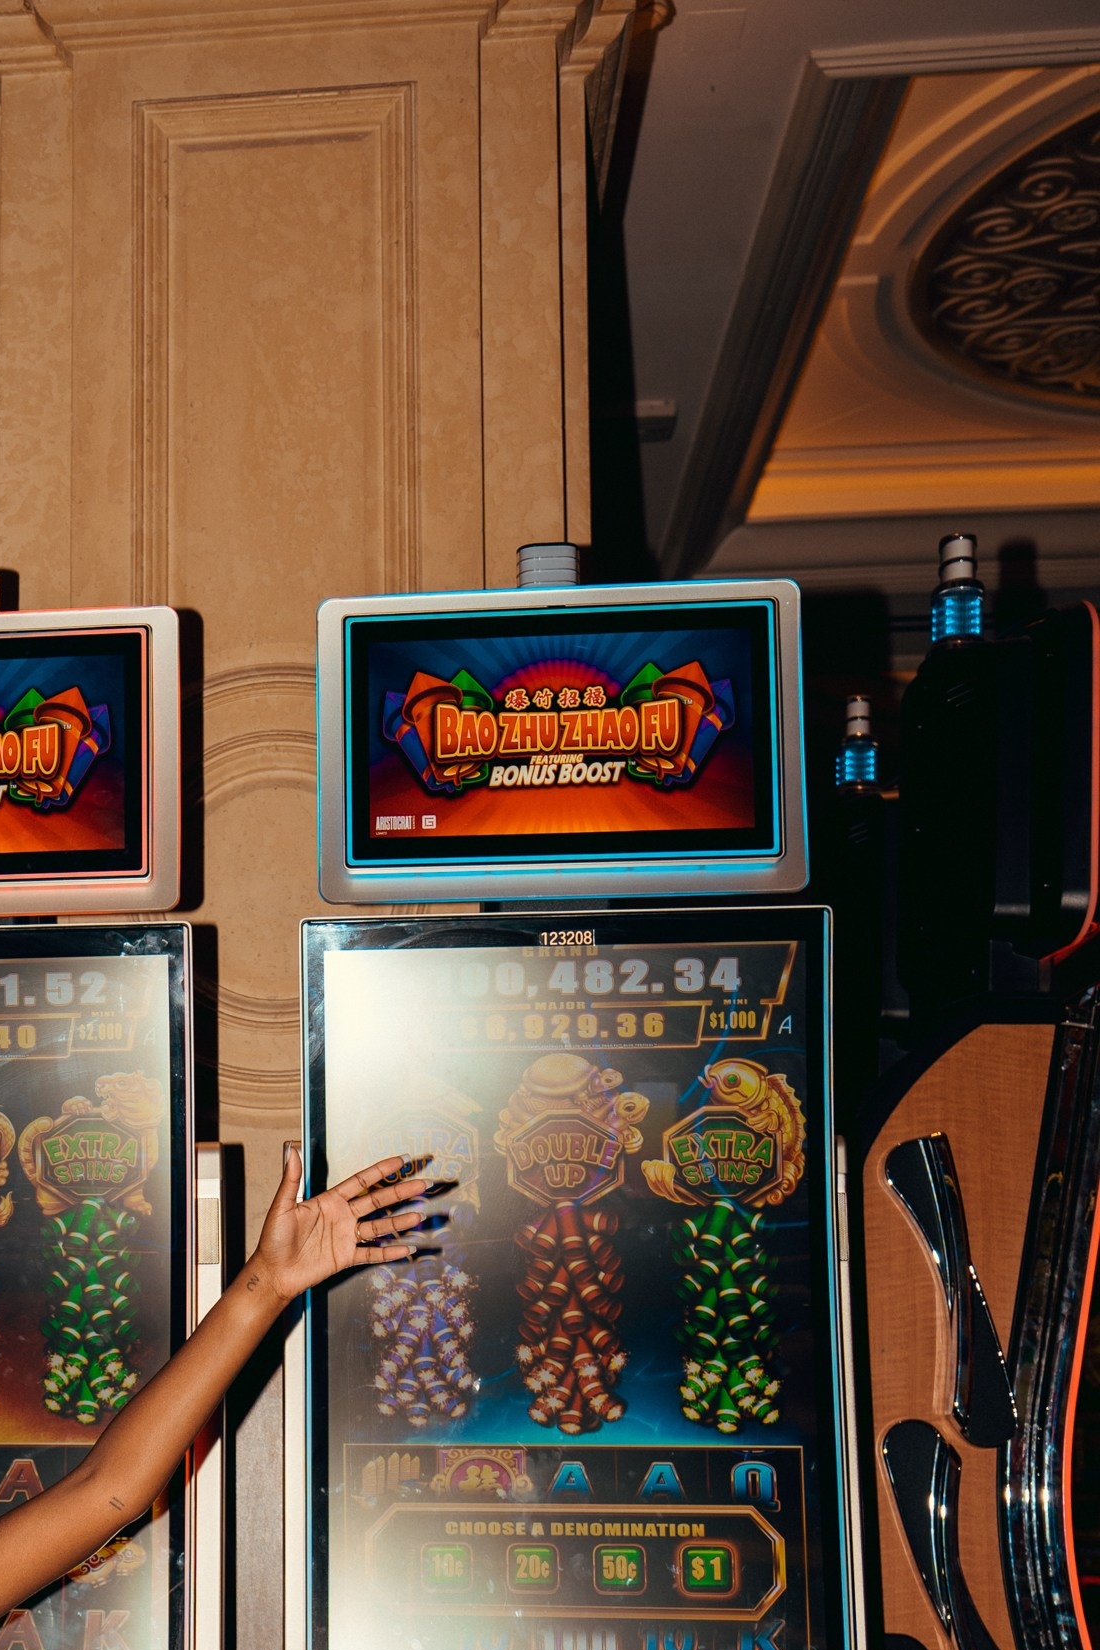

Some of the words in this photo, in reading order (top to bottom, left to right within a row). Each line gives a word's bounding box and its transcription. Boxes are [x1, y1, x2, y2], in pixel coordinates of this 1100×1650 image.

[436, 703, 498, 759] BAO
[499, 711, 558, 753] ZHU
[560, 706, 639, 750] ZHAO
[641, 698, 681, 751] FU
[23, 723, 59, 774] FU
[530, 754, 584, 766] FEATURING
[489, 765, 558, 788] BONUS
[558, 761, 626, 784] BOOST
[541, 930, 592, 946] 123208
[522, 946, 599, 957] GRAND
[535, 1001, 586, 1010] MAJOR
[78, 1022, 122, 1042] $2,000
[709, 1010, 756, 1030] $1,000
[43, 1131, 137, 1167] EXTRA
[507, 1132, 622, 1171] DOUBLE
[669, 1130, 773, 1168] EXTRA
[54, 1161, 127, 1184] SPINS
[544, 1163, 586, 1187] UP
[682, 1161, 762, 1185] SPINS
[636, 1461, 688, 1499] A
[731, 1461, 781, 1512] Q
[445, 1521, 526, 1536] CHOOSE
[532, 1522, 545, 1536] A
[550, 1522, 705, 1537] DENOMINATION
[516, 1554, 550, 1580] 20¢
[602, 1555, 637, 1580] 50¢
